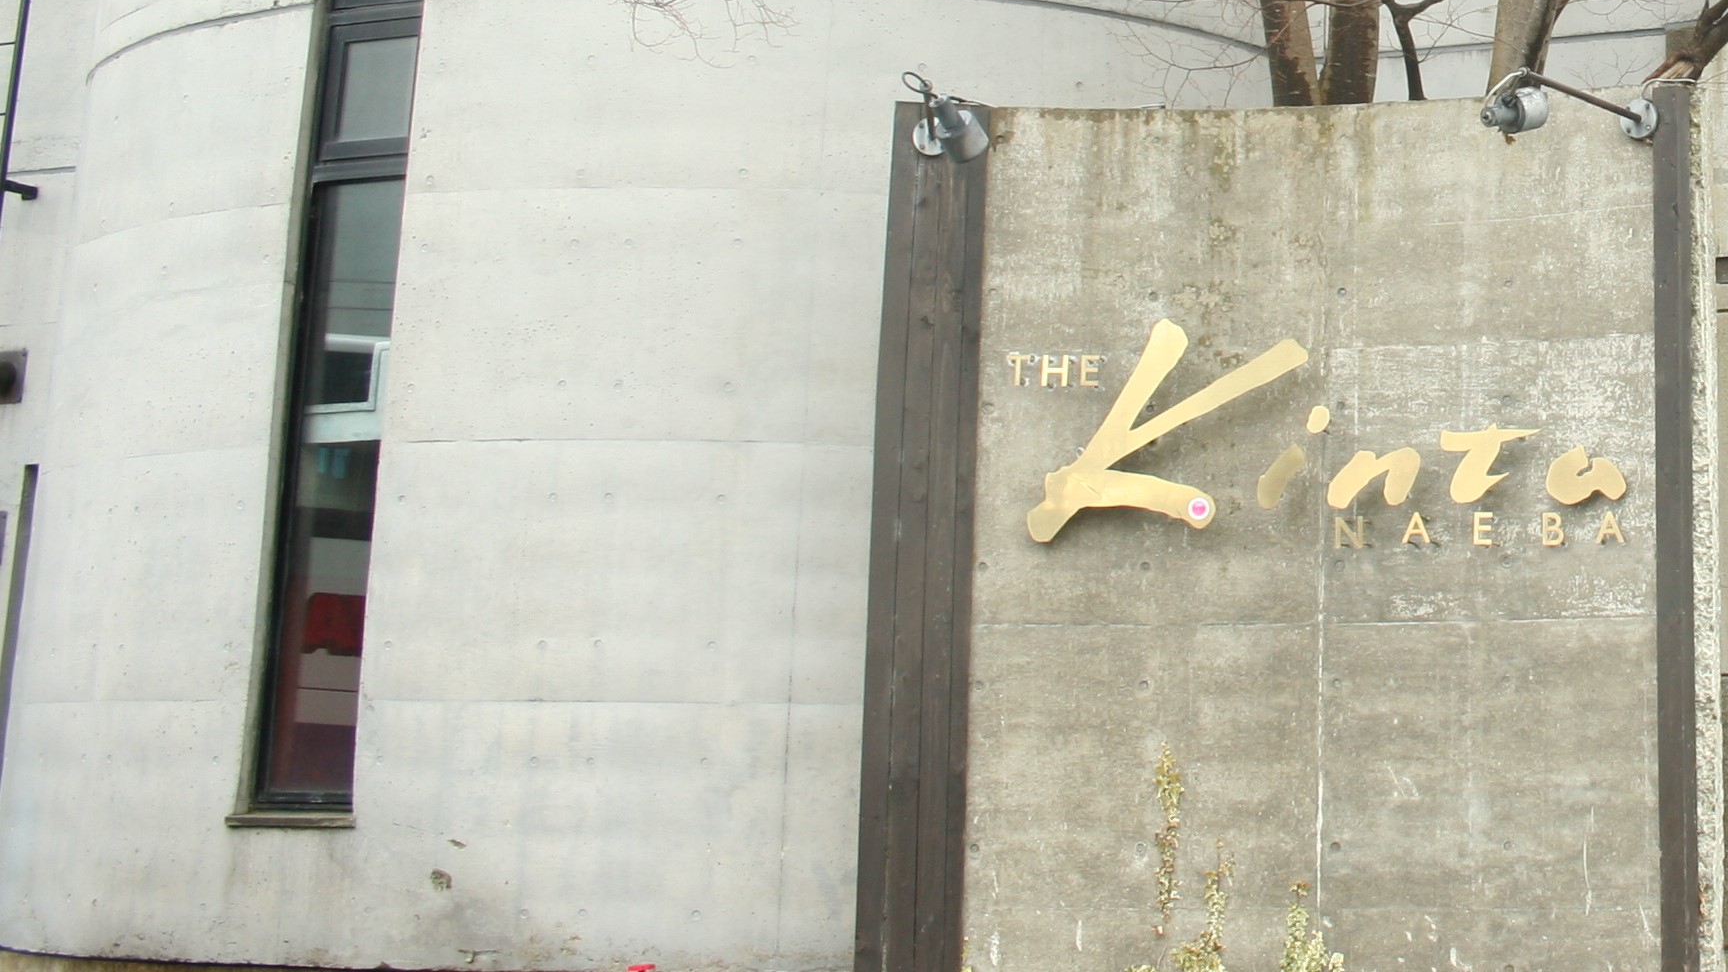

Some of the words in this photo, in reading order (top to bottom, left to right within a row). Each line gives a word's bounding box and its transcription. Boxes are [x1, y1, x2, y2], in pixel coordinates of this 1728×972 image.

[1006, 354, 1100, 387] THE
[1027, 318, 1628, 543] Kinta
[1334, 511, 1625, 549] NAEBA
